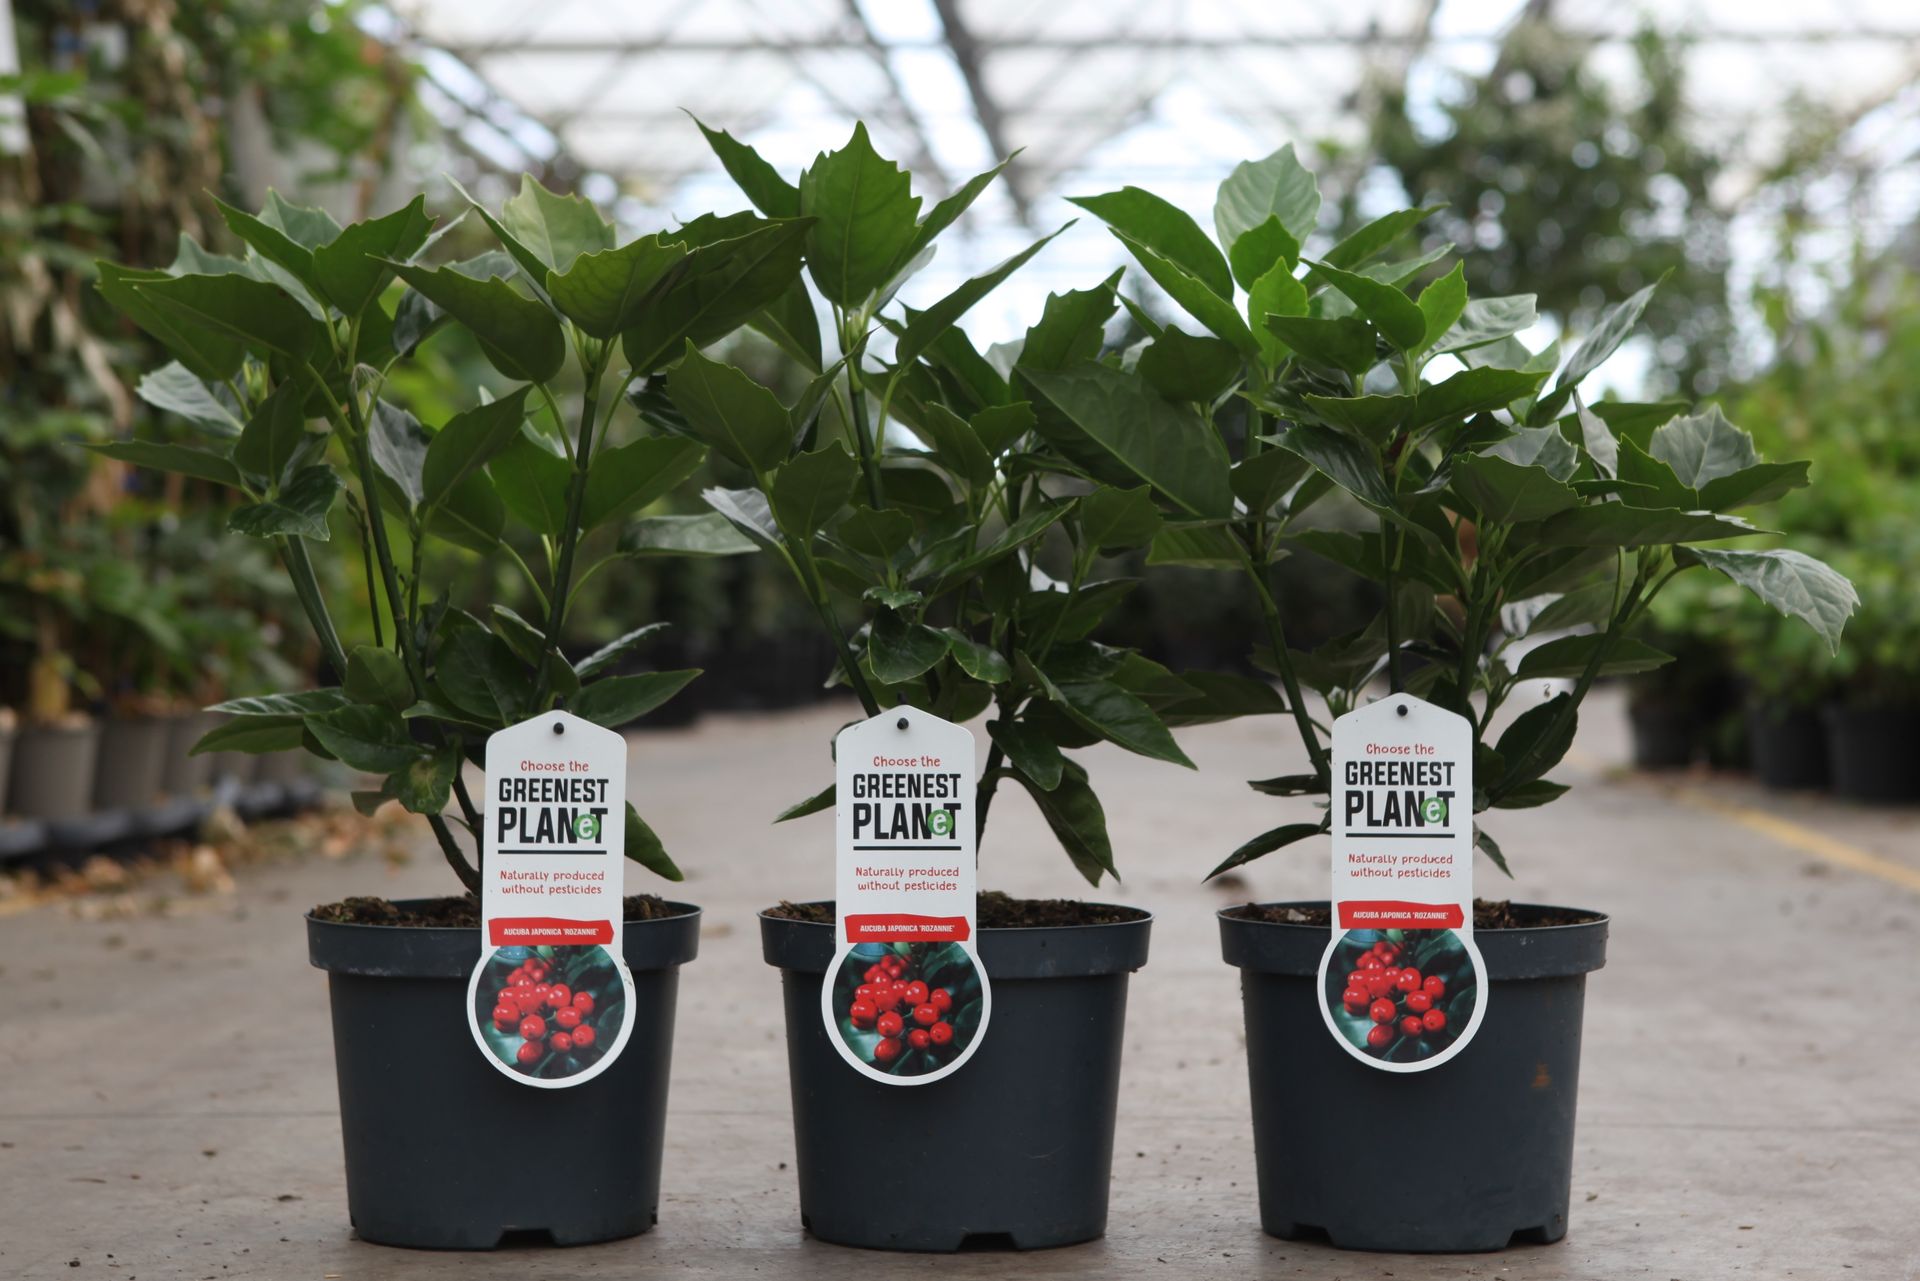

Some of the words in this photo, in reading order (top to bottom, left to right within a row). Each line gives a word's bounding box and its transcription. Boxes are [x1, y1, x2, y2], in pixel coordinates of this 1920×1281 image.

[1366, 743, 1410, 755] Choose
[1415, 743, 1434, 755] the
[521, 760, 565, 772] Choose
[570, 760, 589, 772] the
[874, 756, 917, 767] Choose
[921, 756, 940, 767] the
[1346, 761, 1455, 786] GREENEST
[499, 778, 609, 803] GREENEST
[853, 774, 961, 798] GREENEST
[1349, 854, 1397, 864] Naturally
[1402, 854, 1453, 864] produced
[500, 871, 549, 881] Naturally
[554, 871, 604, 881] produced
[856, 867, 904, 877] Naturally
[909, 867, 959, 877] produced
[1351, 868, 1392, 877] without
[1398, 868, 1450, 878] pesticides
[502, 885, 544, 894] without
[549, 885, 602, 895] pesticides
[858, 881, 900, 890] without
[905, 881, 957, 891] pesticides
[531, 928, 561, 936] JAPONICA
